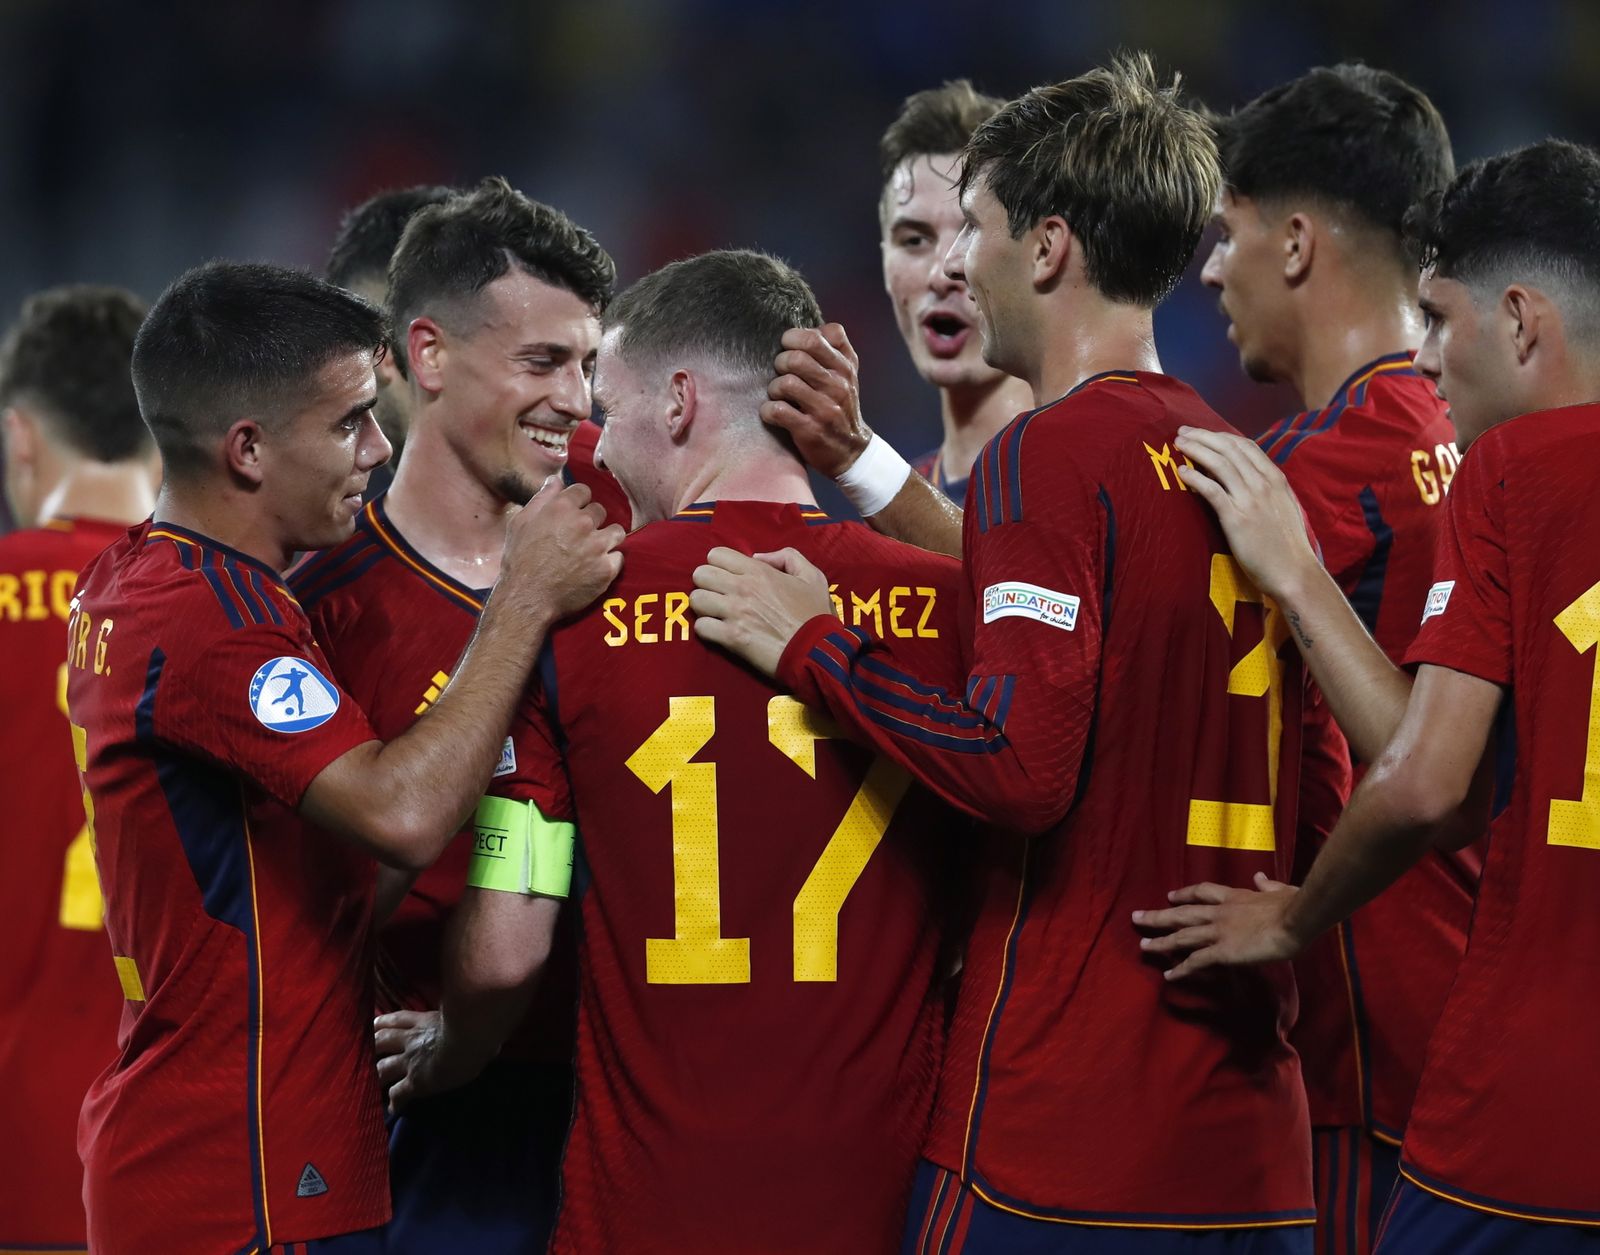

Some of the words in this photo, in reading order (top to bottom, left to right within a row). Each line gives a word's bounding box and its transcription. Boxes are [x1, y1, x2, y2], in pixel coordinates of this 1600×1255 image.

[1040, 612, 1049, 620] for
[1050, 616, 1073, 628] children
[1186, 553, 1285, 852] 3
[624, 695, 914, 984] 17
